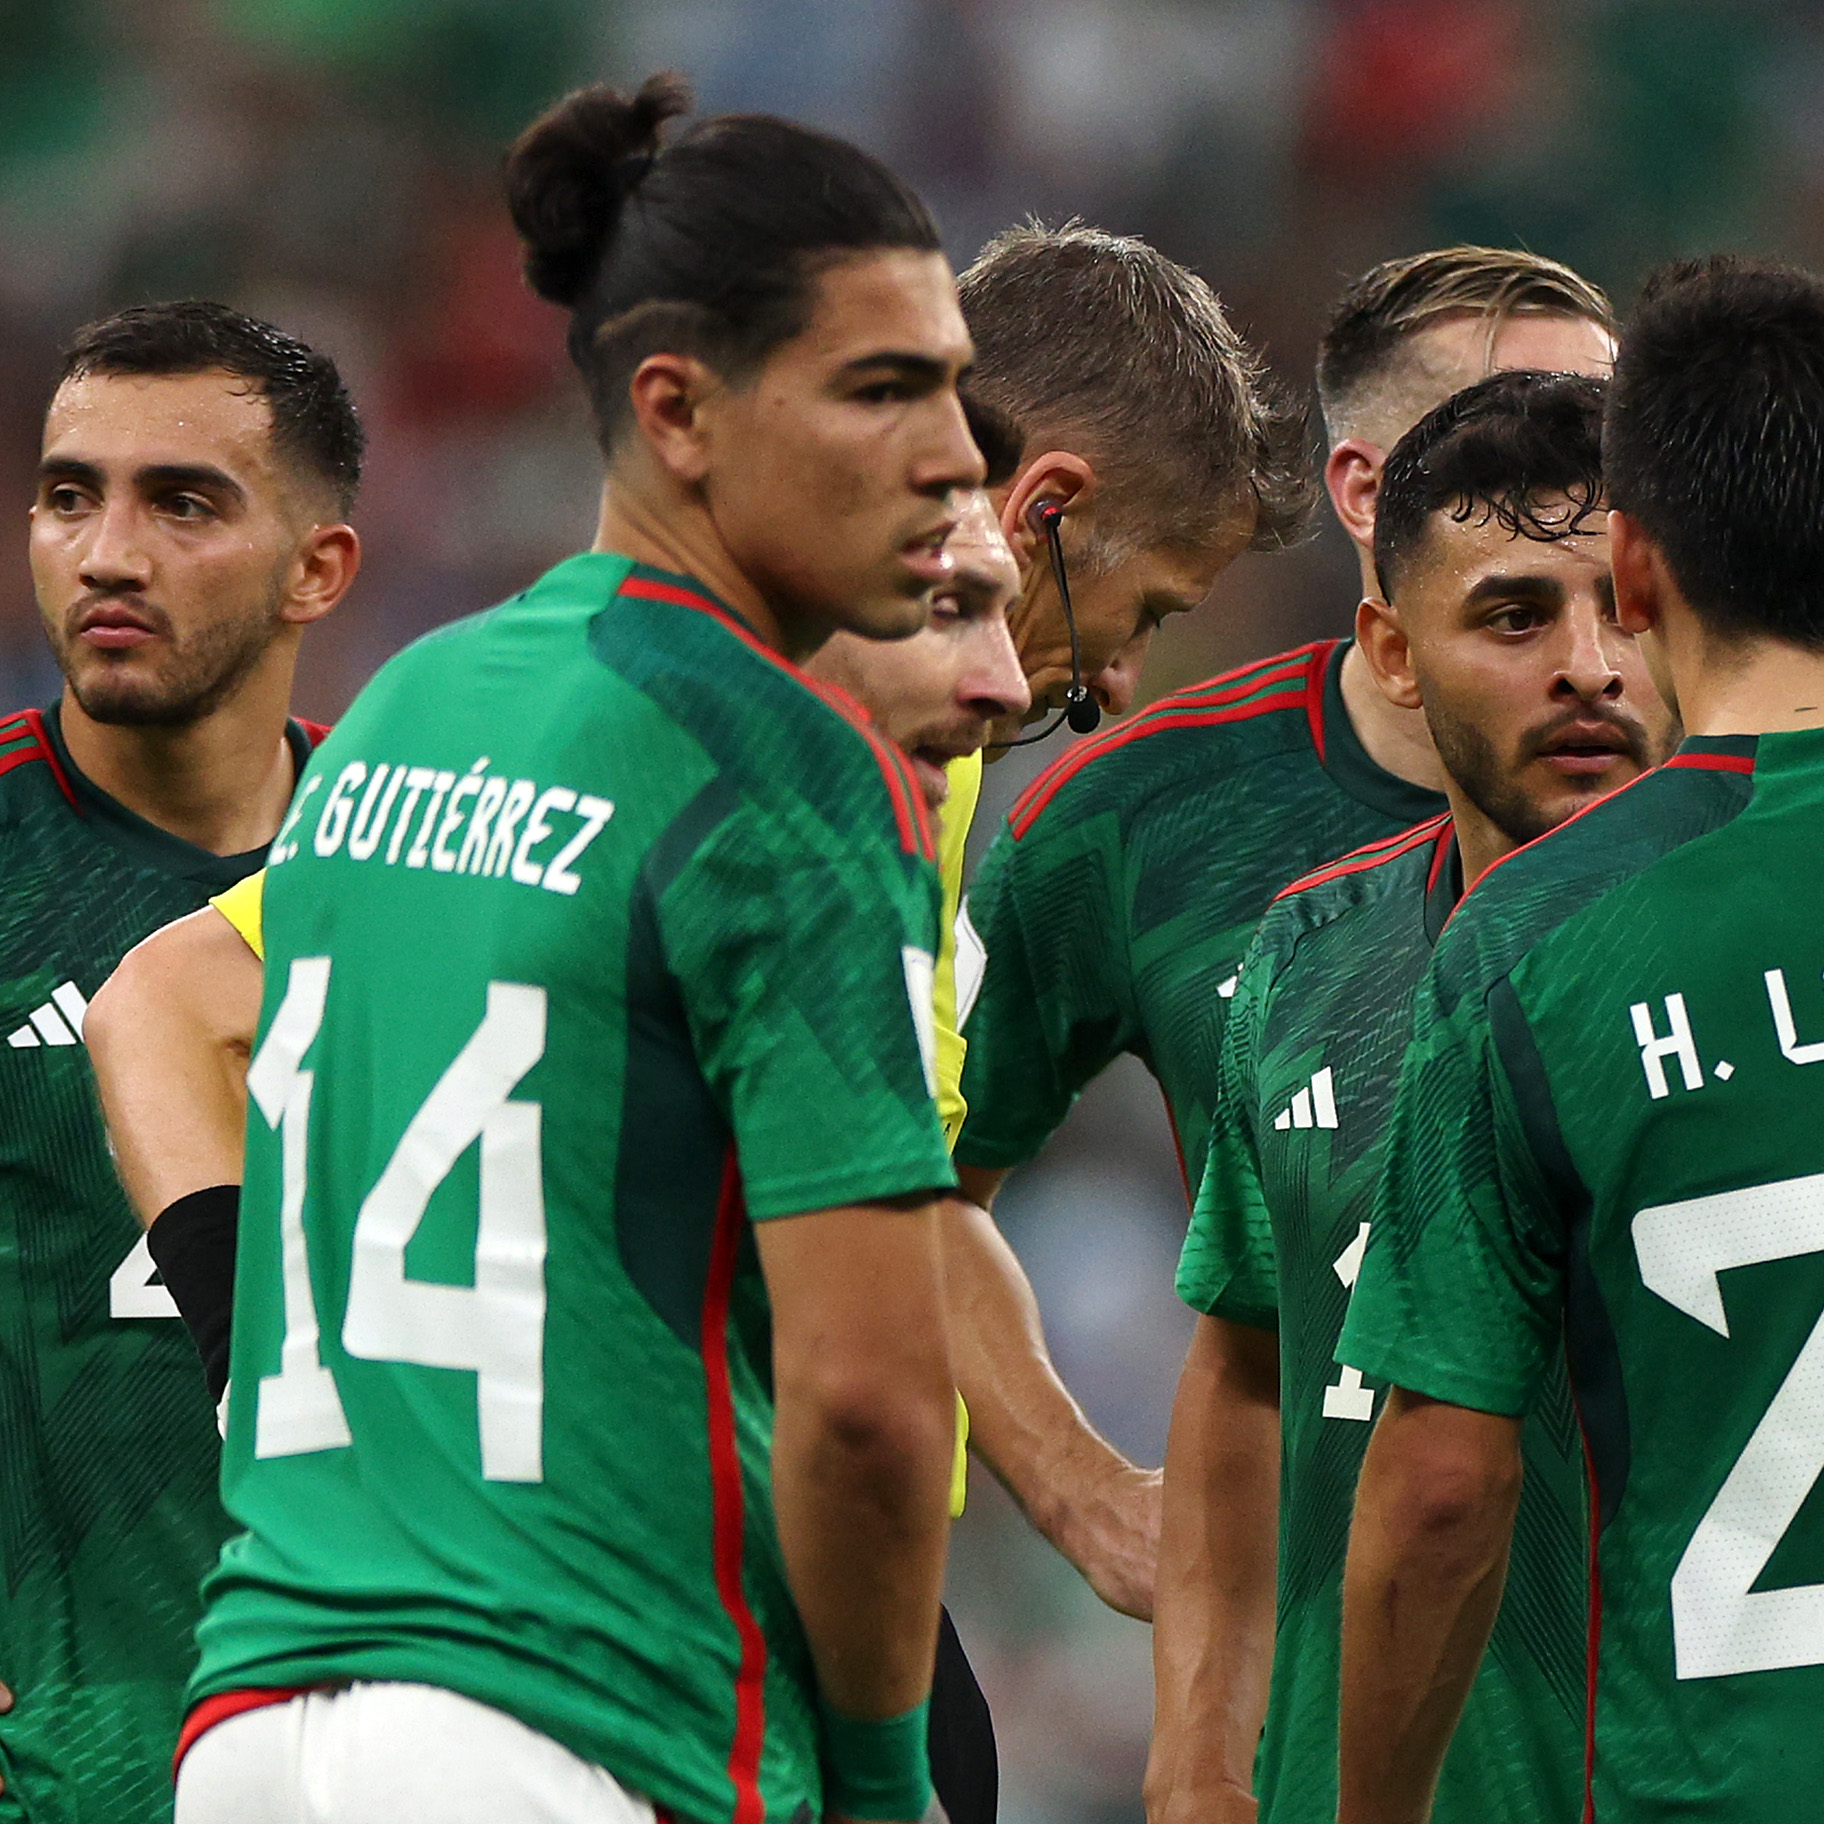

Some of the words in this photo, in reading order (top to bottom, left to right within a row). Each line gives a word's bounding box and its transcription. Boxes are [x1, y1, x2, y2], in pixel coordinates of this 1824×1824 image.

[313, 755, 615, 896] GUTIÉRREZ
[1629, 993, 1736, 1100] H.
[246, 955, 547, 1483] 14
